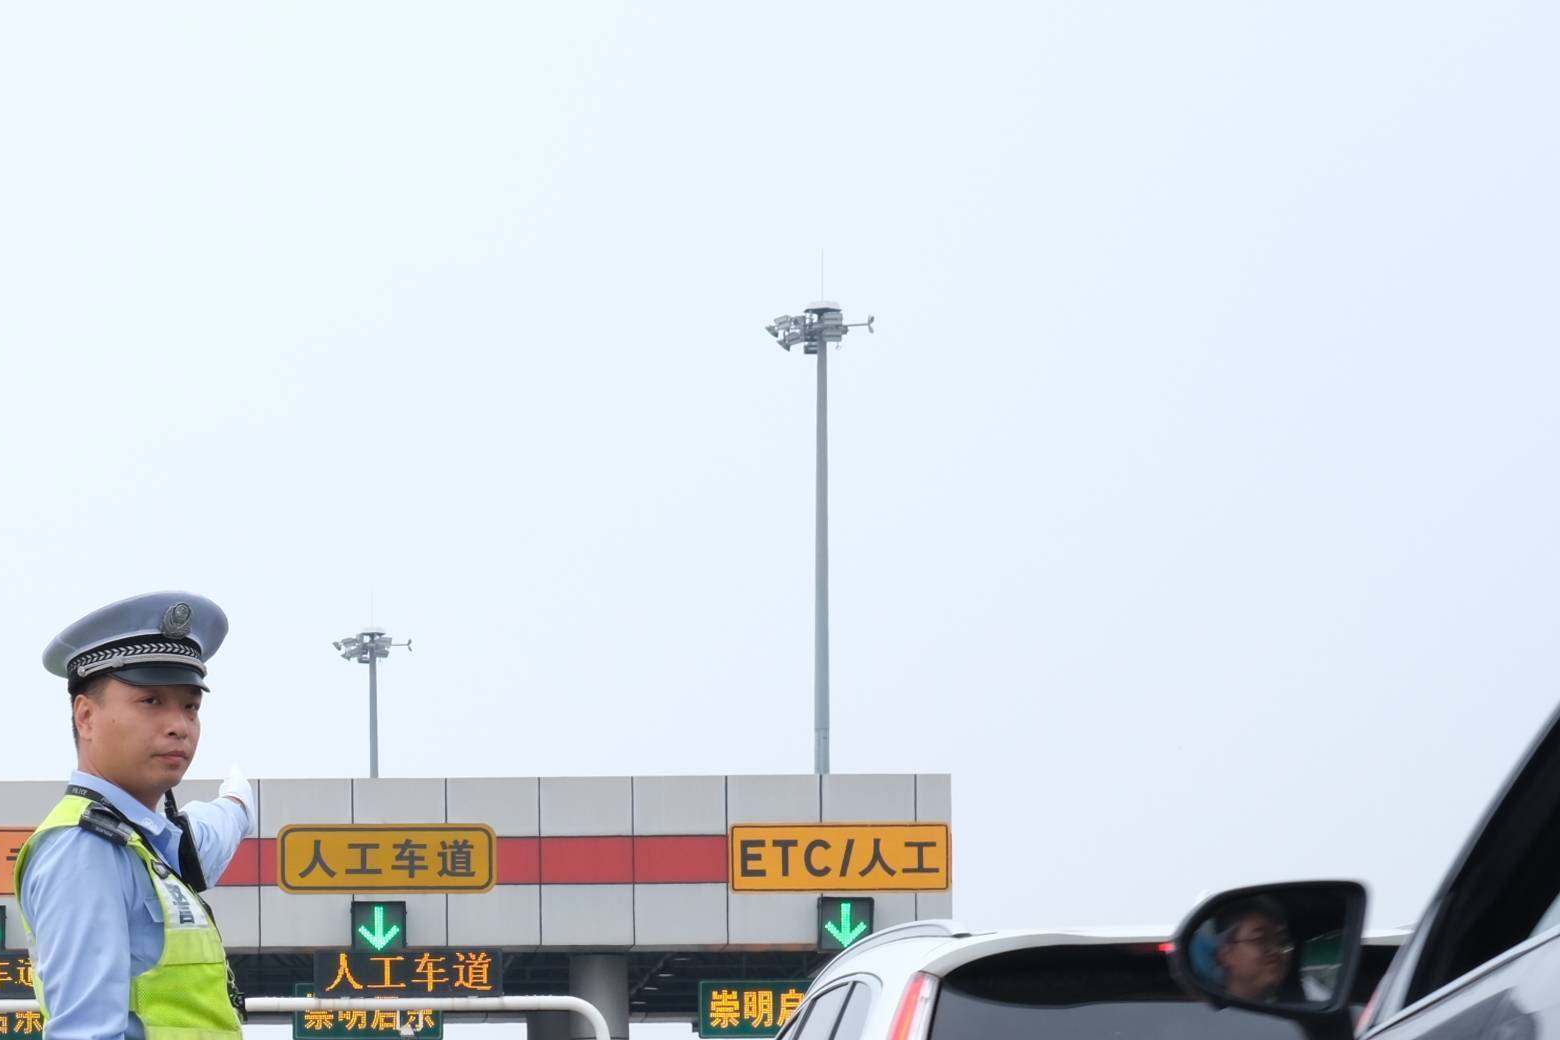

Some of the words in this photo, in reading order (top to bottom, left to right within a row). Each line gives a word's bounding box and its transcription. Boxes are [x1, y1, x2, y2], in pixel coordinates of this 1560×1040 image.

[298, 840, 477, 880] 人工车道
[739, 838, 940, 879] ETC/人工
[326, 952, 493, 992] 人工车道
